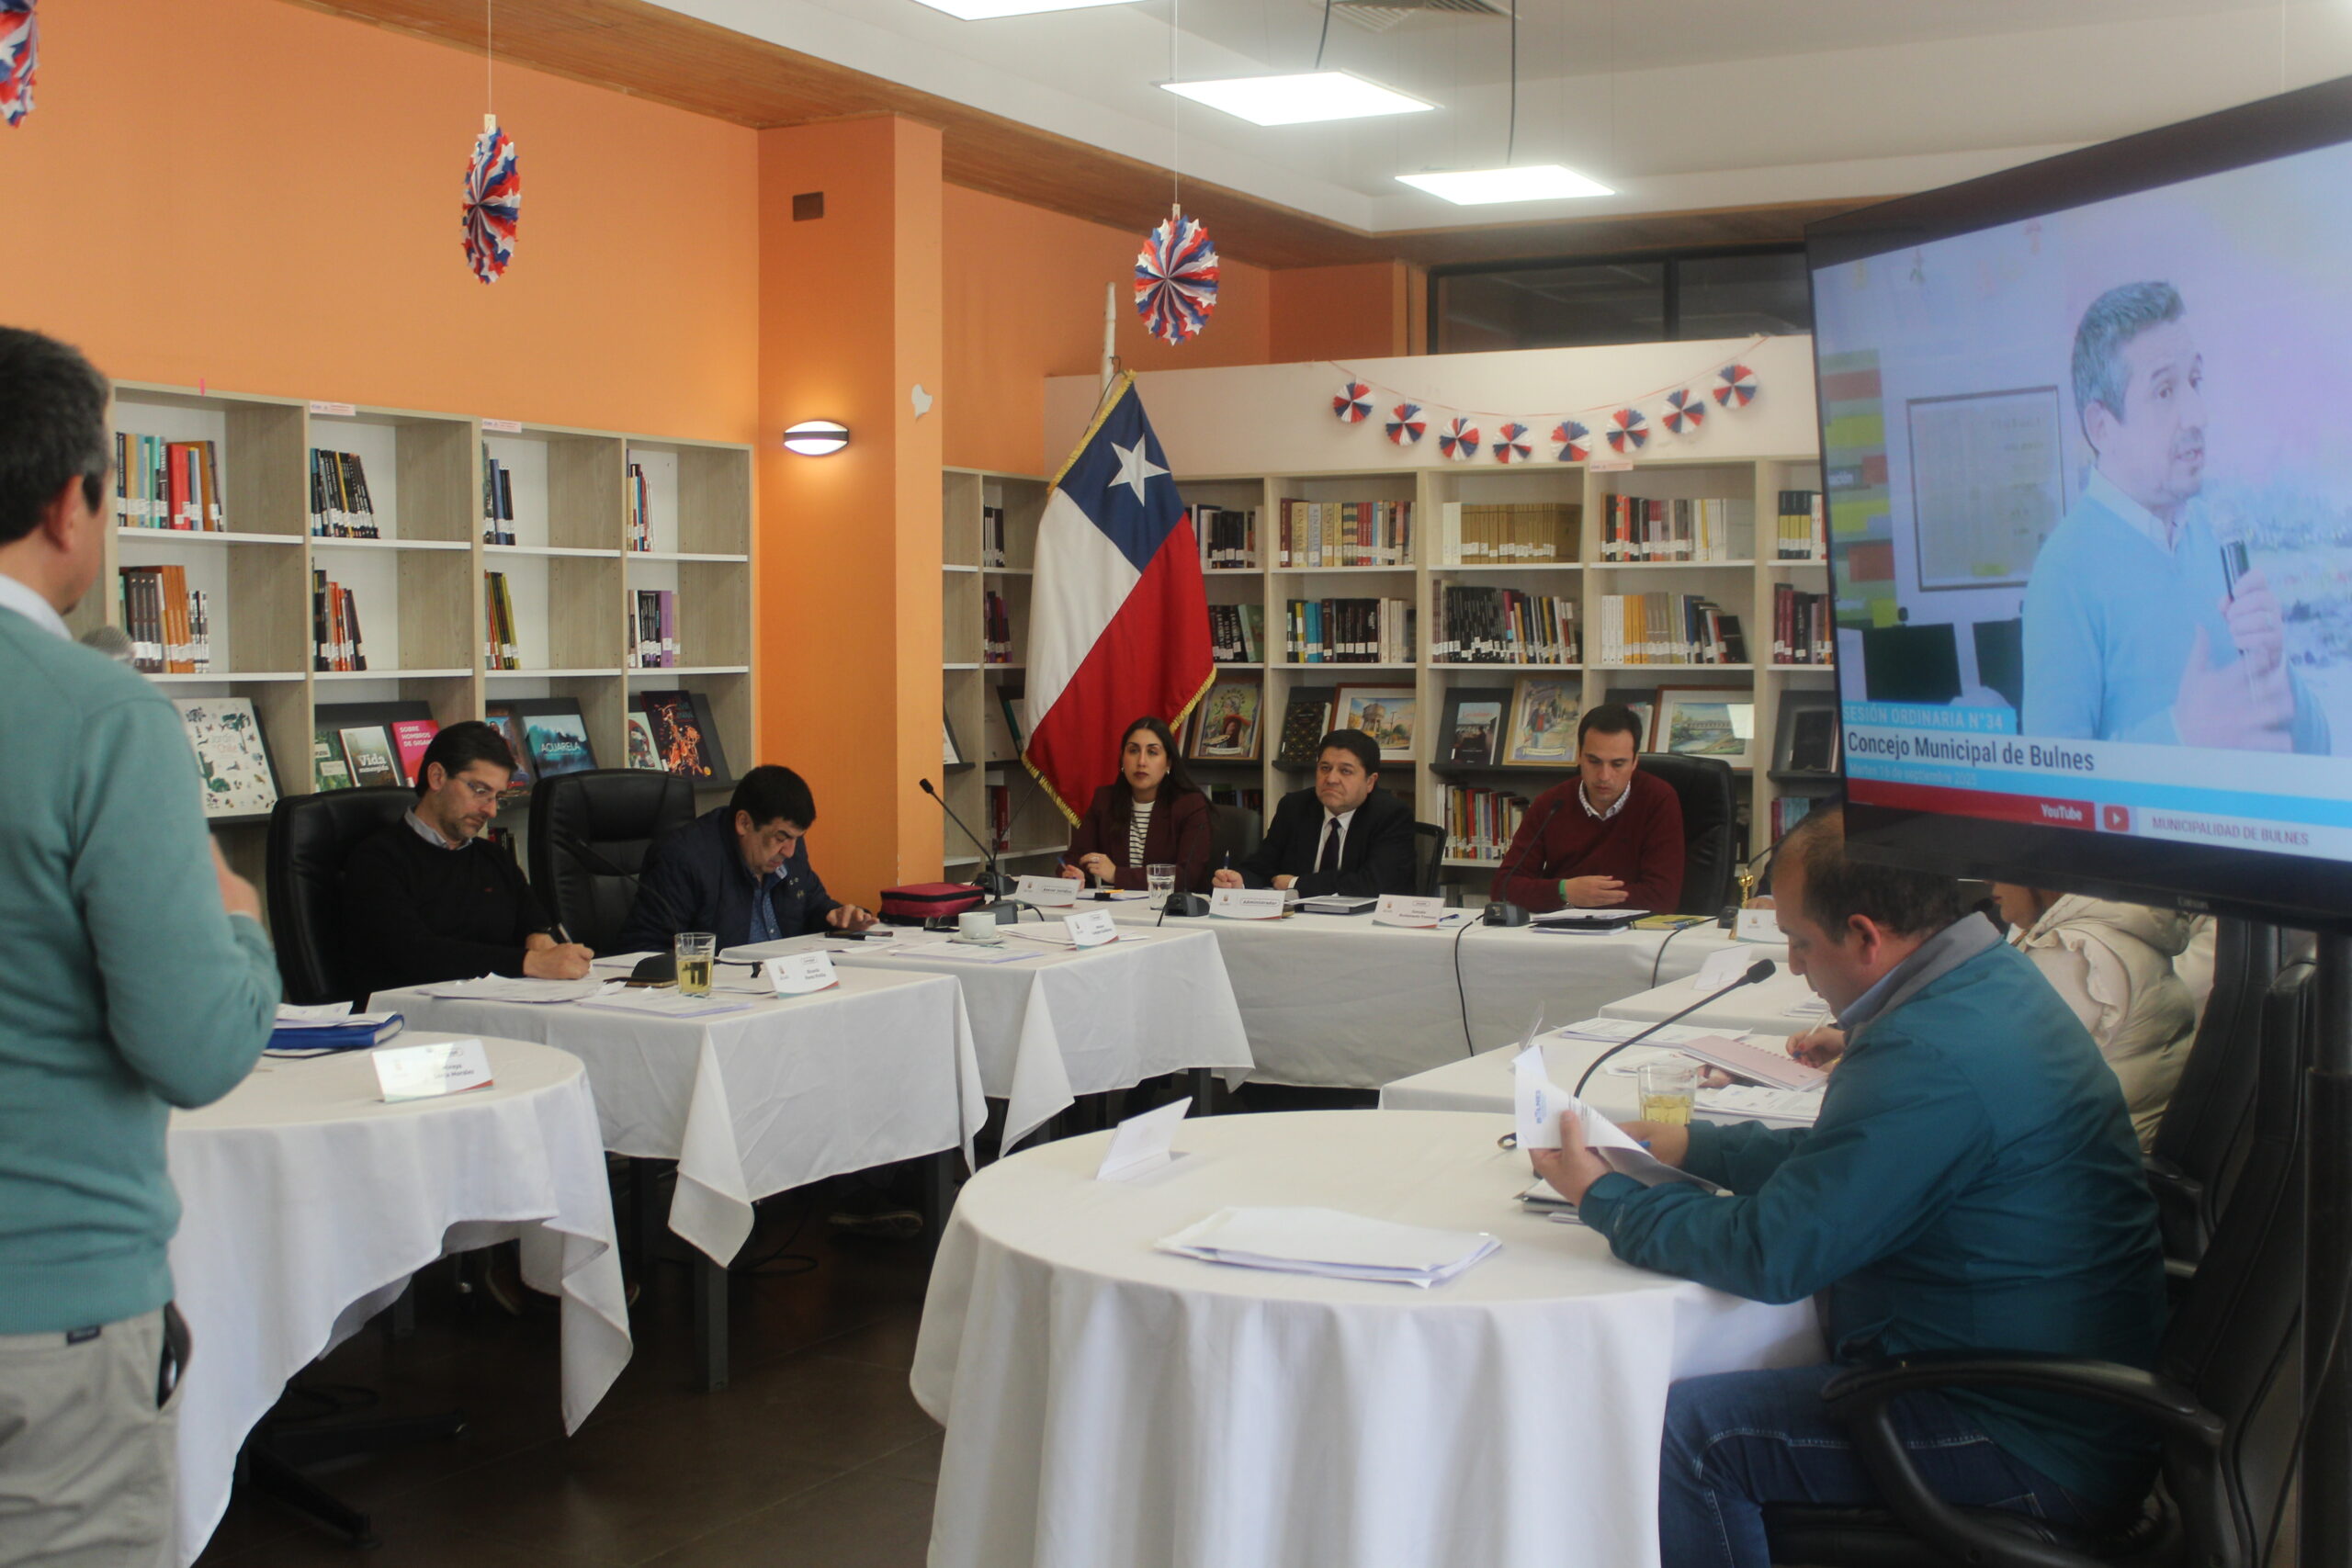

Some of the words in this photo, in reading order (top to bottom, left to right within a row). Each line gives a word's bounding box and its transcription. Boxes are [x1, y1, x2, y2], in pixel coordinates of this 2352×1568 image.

[1842, 703, 1887, 722] SESIÓN
[1891, 708, 1965, 728] ORDINARIA
[541, 741, 581, 751] ACUARELA
[1848, 732, 1909, 760] Concejo
[1915, 737, 1996, 767] Municipal
[2003, 742, 2024, 765] de
[2030, 744, 2095, 772] Bulnes
[359, 753, 387, 766] Vida
[2041, 804, 2083, 821] YouTube
[2152, 816, 2240, 839] MUNICIPALIDAD
[2243, 825, 2257, 840] DE
[2261, 828, 2309, 845] BULNES
